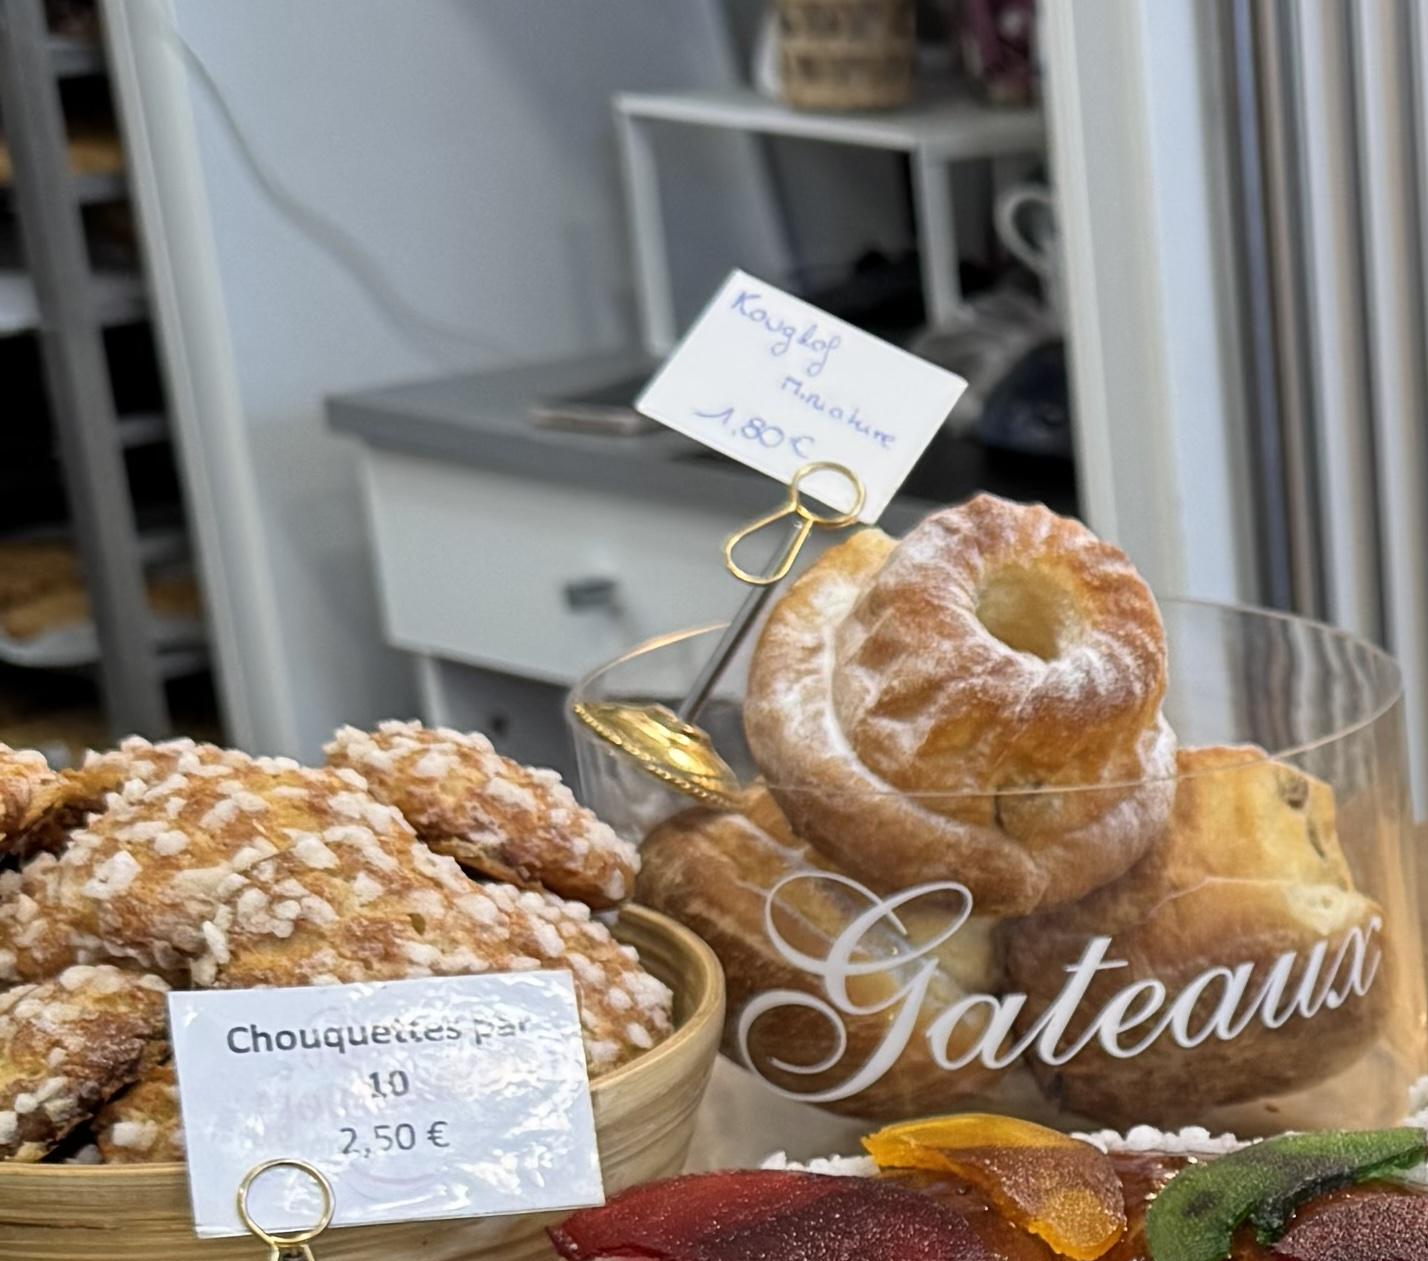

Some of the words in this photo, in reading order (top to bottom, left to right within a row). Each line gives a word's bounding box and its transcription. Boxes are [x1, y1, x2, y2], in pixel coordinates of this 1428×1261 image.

[737, 870, 1384, 1103] Gateaux
[226, 1014, 462, 1054] Chouquettes
[368, 1069, 410, 1099] 10
[338, 1121, 417, 1160] 2,50
[427, 1119, 451, 1150] €
